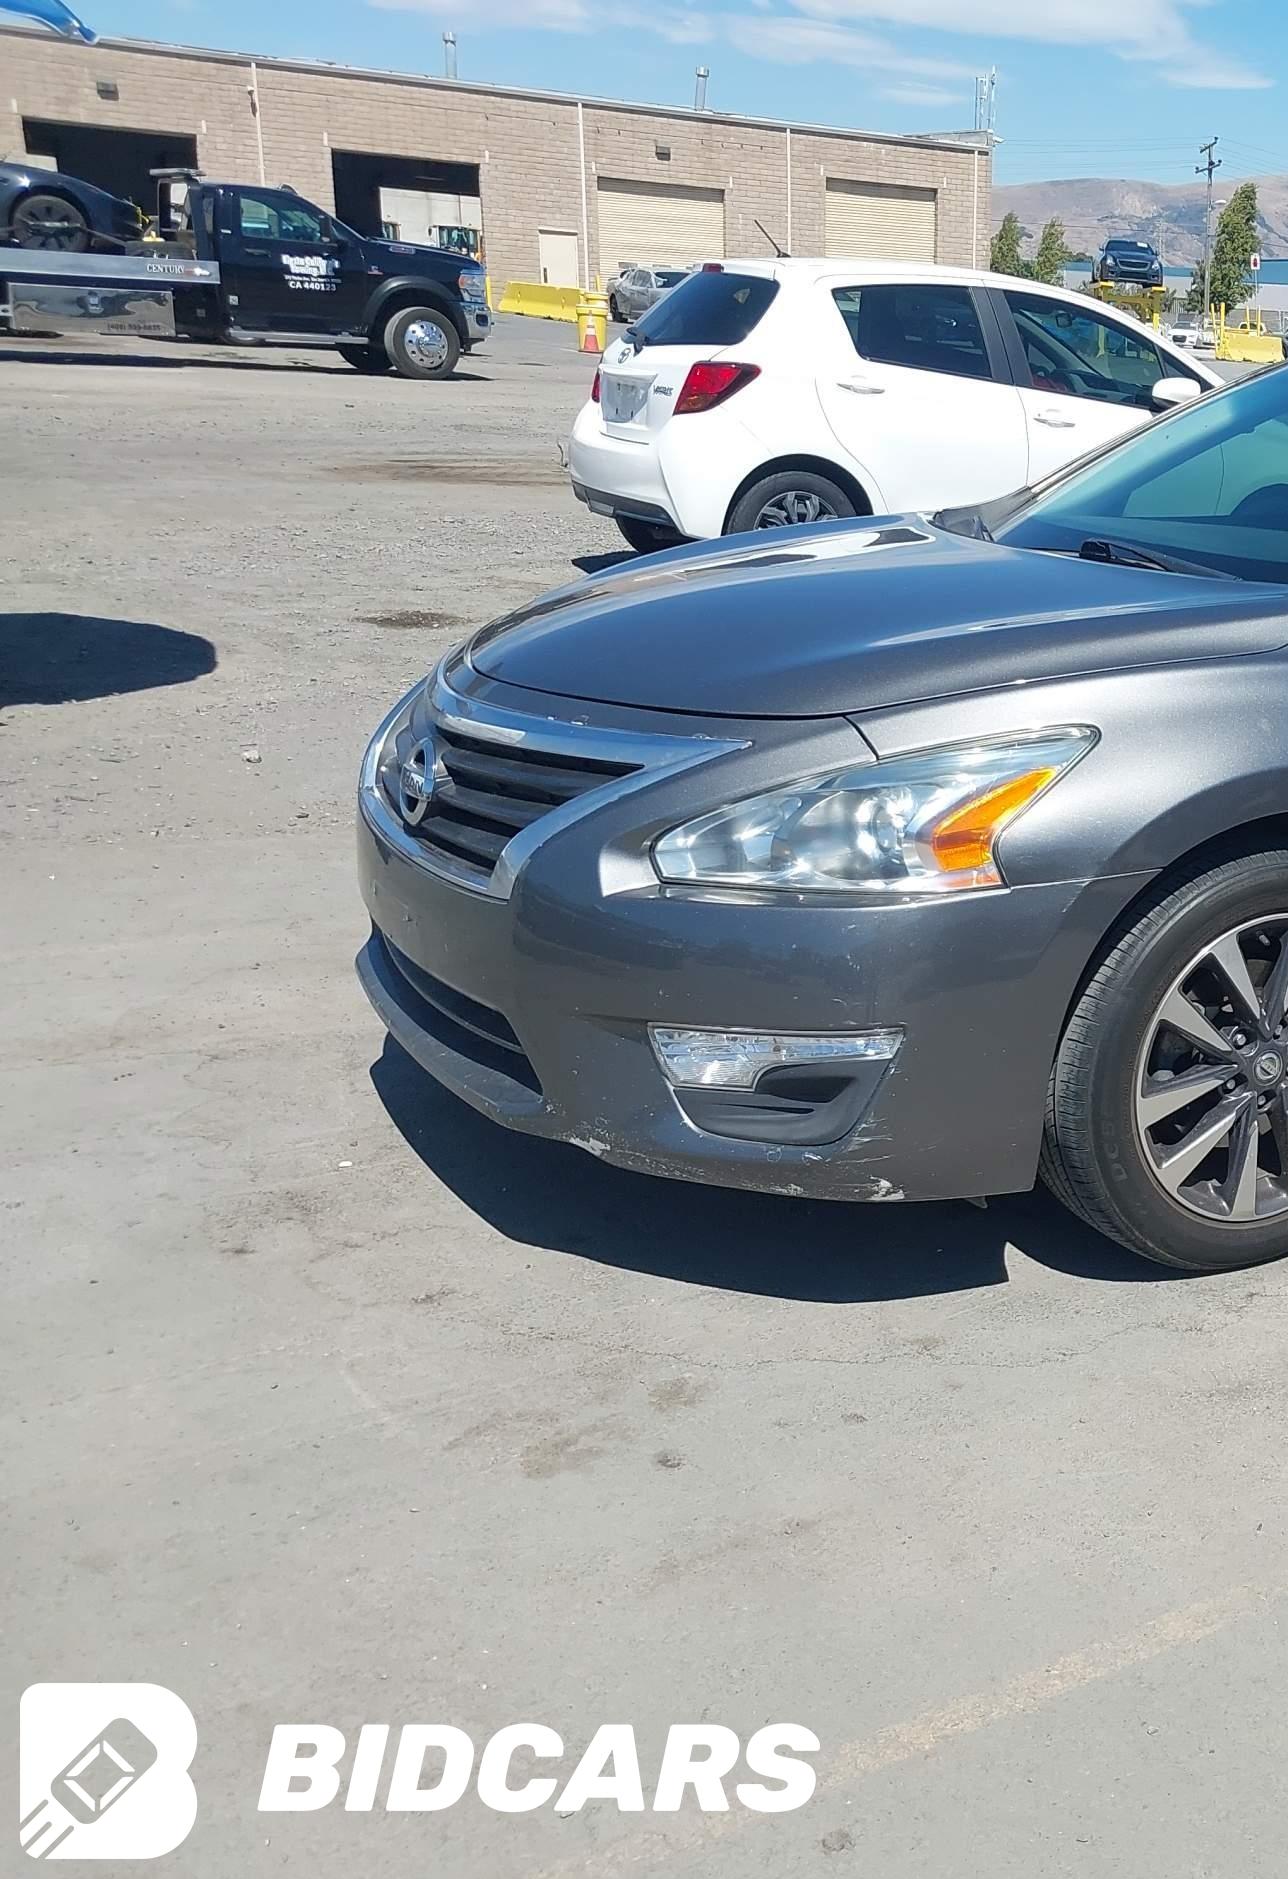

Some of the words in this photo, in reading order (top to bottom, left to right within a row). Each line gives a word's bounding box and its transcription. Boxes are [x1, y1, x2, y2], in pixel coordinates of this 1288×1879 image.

[146, 263, 184, 274] CENTURY
[289, 280, 303, 289] CA
[303, 282, 337, 291] 440123
